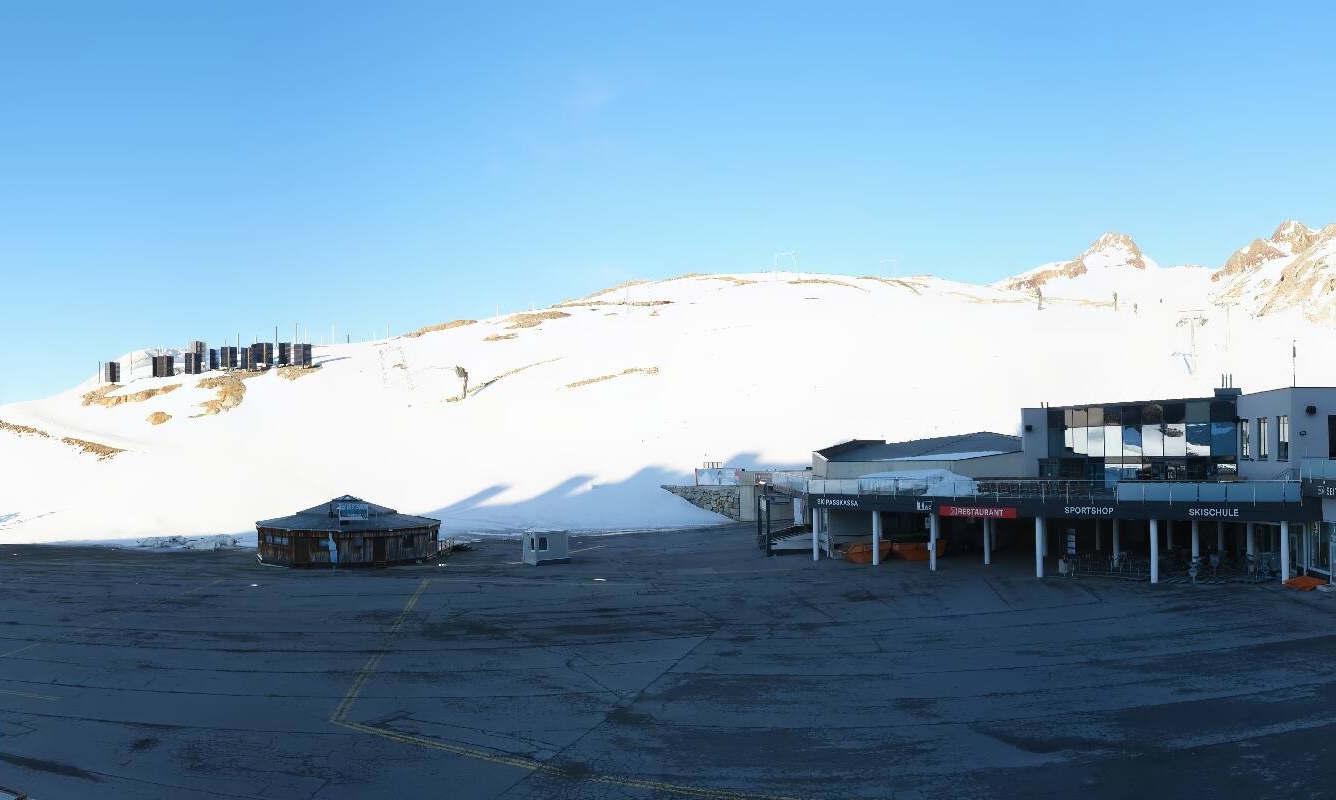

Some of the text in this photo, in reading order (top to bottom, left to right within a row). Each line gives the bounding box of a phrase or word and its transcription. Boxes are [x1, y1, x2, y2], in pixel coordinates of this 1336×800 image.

[958, 507, 1004, 517] RESTAURANT
[1064, 506, 1114, 515] SPORTSHOP
[1189, 508, 1239, 517] SKISCHULE
